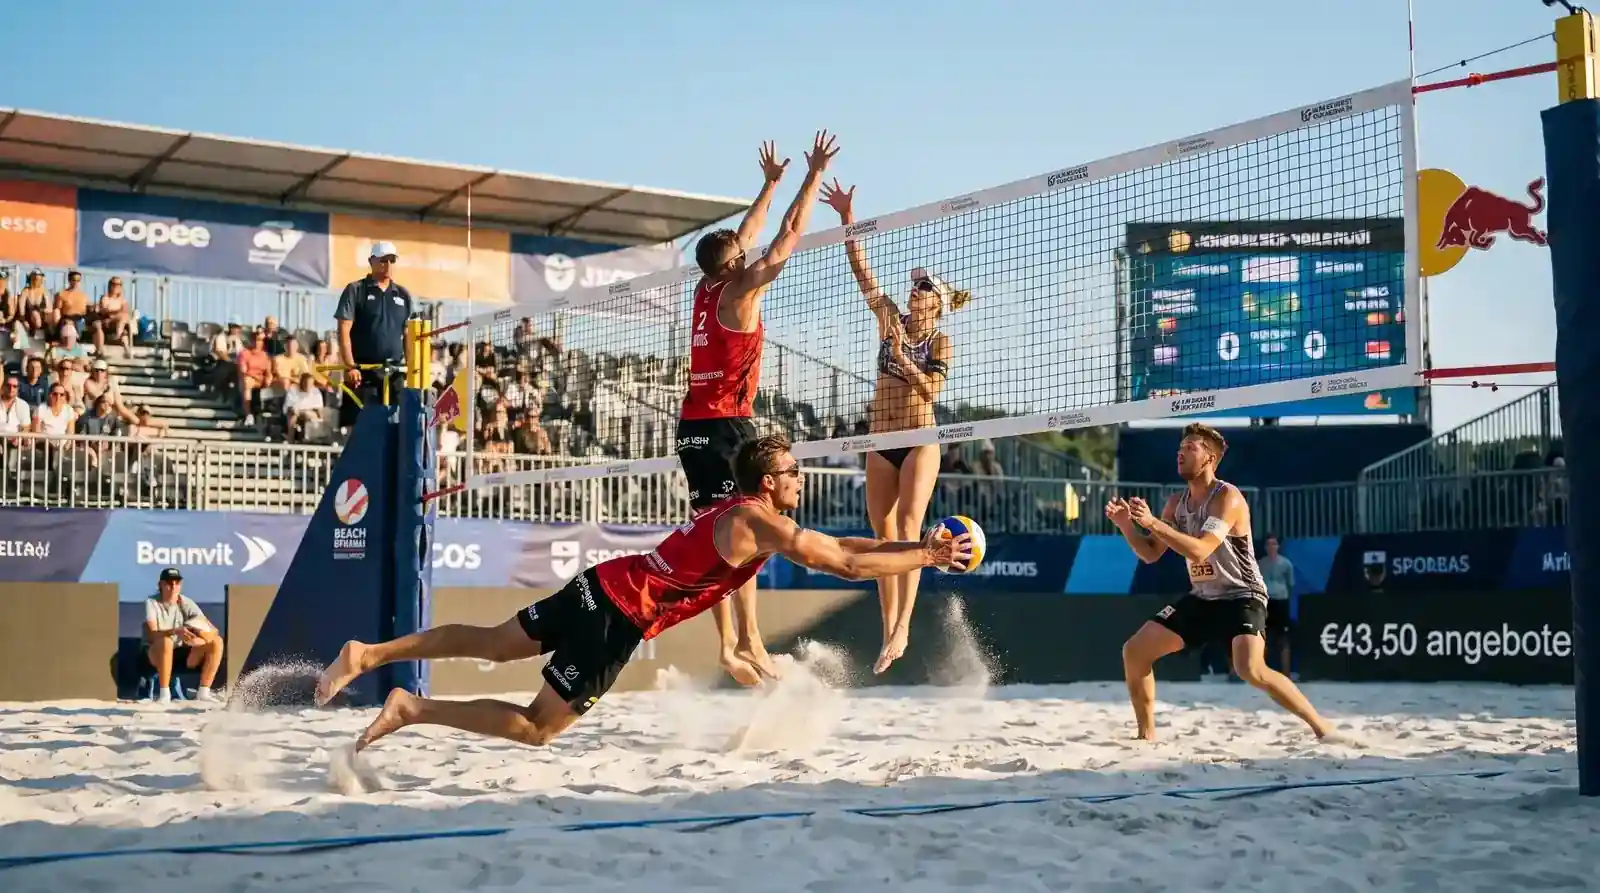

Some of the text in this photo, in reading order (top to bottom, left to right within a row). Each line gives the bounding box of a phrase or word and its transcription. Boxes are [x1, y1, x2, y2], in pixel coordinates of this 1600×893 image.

[103, 217, 211, 248] copee
[697, 311, 708, 331] 2
[1218, 332, 1240, 361] 0
[1304, 331, 1327, 359] 0
[334, 528, 366, 539] BEACH
[136, 541, 233, 566] Bannvit
[1320, 623, 1572, 664] €43,50 angebote
